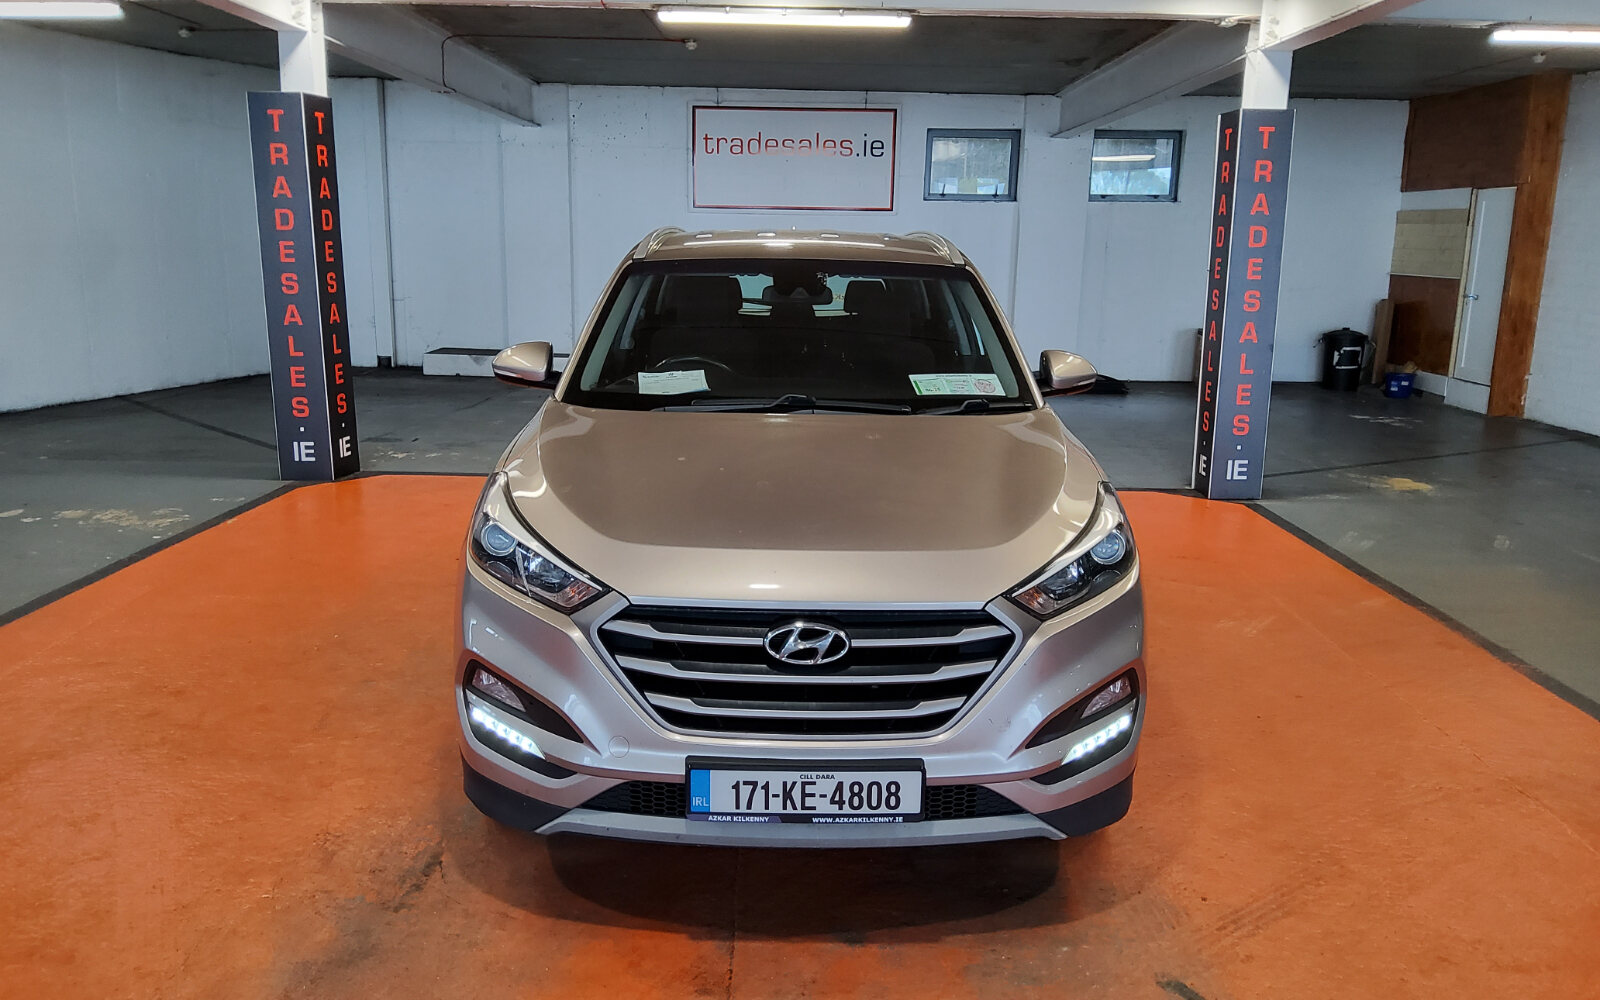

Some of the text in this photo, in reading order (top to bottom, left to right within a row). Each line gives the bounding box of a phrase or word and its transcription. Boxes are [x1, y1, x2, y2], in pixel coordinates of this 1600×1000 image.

[702, 131, 885, 158] tradesales.ie
[692, 797, 709, 807] IRL
[731, 780, 901, 811] 171-KE-4808
[733, 815, 770, 823] KILKENNY
